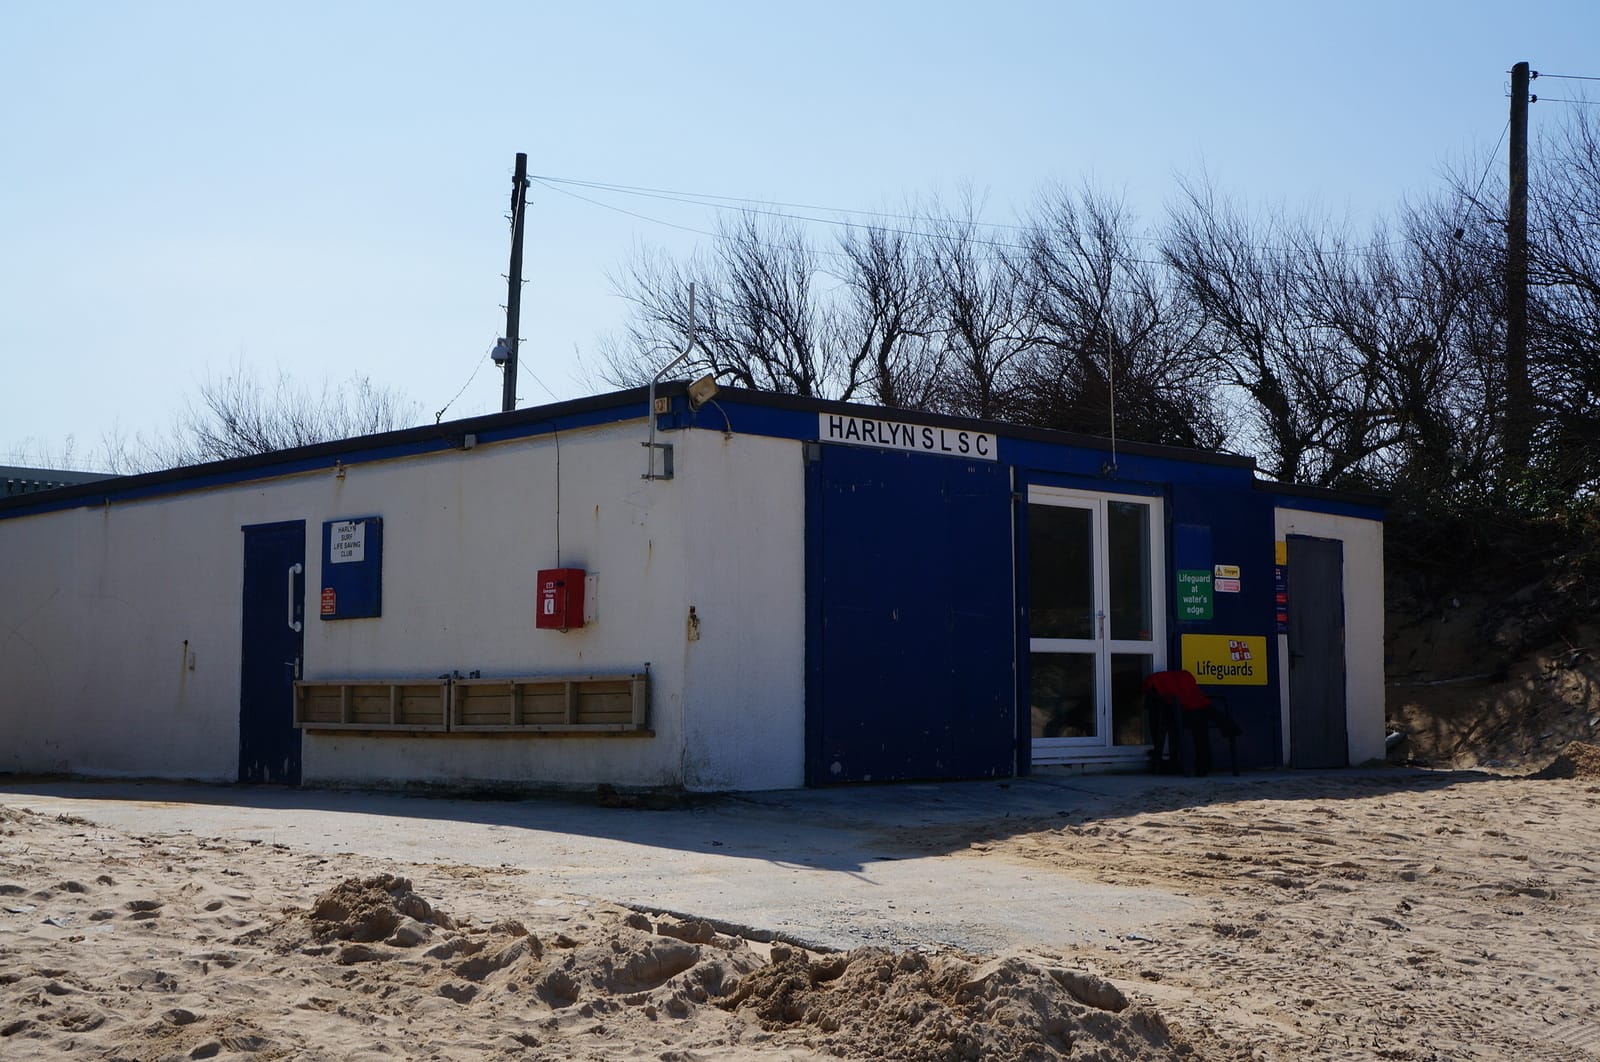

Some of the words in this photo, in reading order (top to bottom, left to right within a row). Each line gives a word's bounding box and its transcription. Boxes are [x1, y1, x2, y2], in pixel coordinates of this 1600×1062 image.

[829, 415, 915, 447] HARLYN
[1179, 574, 1210, 584] Lifeguard
[1191, 585, 1198, 593] at
[1183, 595, 1207, 603] water's
[1187, 605, 1204, 615] edge
[1197, 661, 1253, 680] Lifeguards
